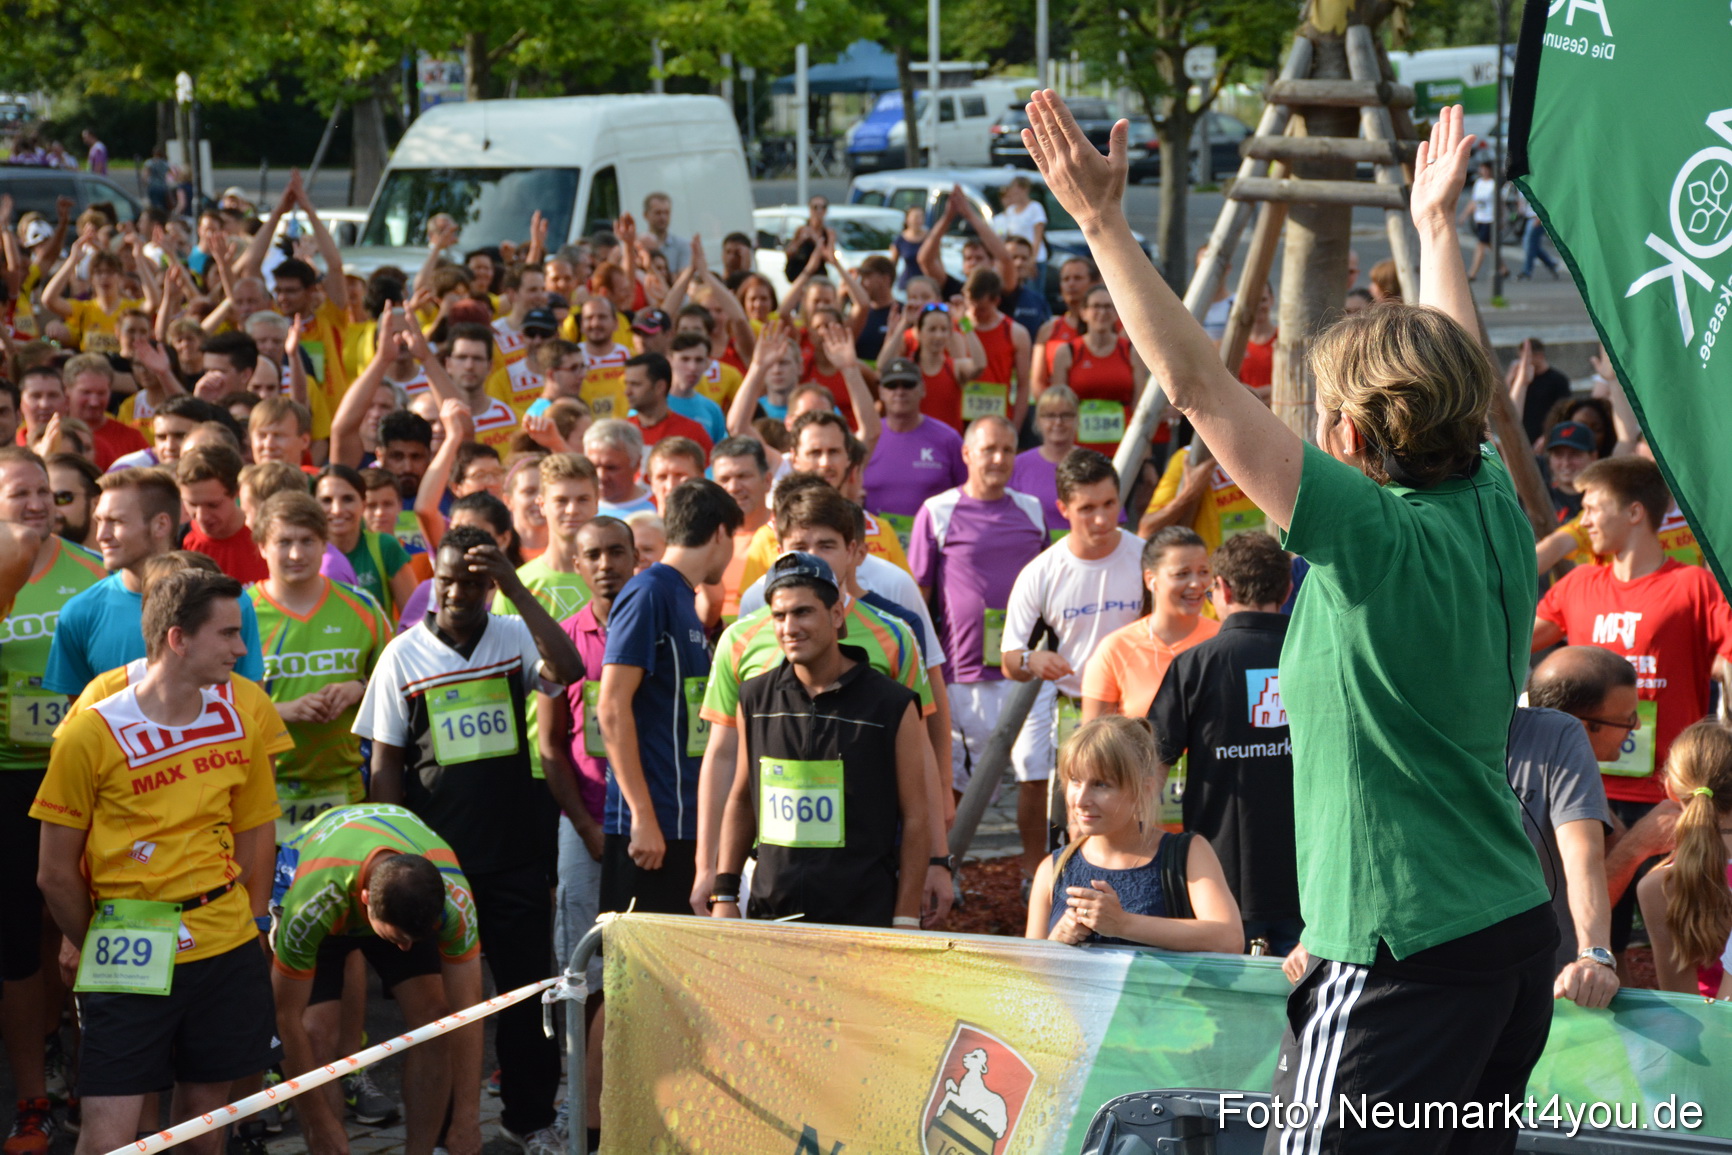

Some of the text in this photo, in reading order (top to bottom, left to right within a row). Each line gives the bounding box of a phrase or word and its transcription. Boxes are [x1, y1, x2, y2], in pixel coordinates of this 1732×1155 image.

[920, 448, 935, 461] K
[441, 709, 507, 741] 1666
[1215, 737, 1293, 760] neumark
[131, 764, 187, 796] MAX
[769, 793, 833, 823] 1660
[94, 935, 152, 967] 829
